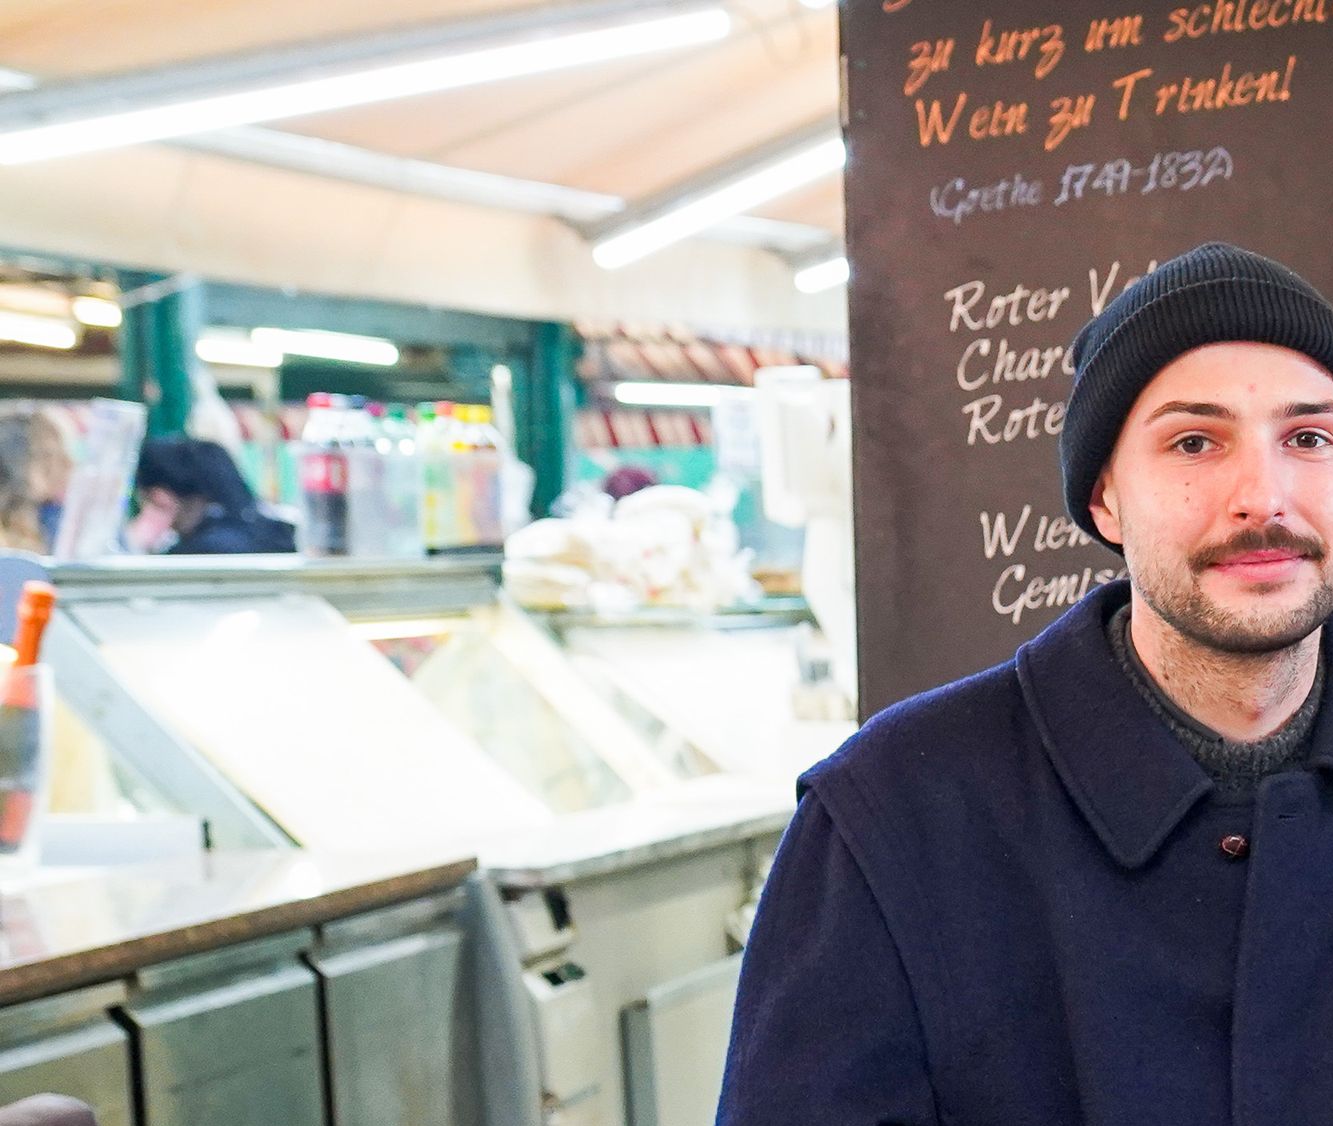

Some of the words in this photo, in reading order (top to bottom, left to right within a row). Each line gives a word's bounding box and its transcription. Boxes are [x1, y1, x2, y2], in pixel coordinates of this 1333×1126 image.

[904, 38, 956, 96] zu
[974, 19, 1066, 80] kurz
[1084, 13, 1144, 53] um
[914, 93, 1030, 149] Wein
[1044, 94, 1098, 152] zu
[943, 280, 1070, 332] Roter
[991, 563, 1131, 626] Gemis
